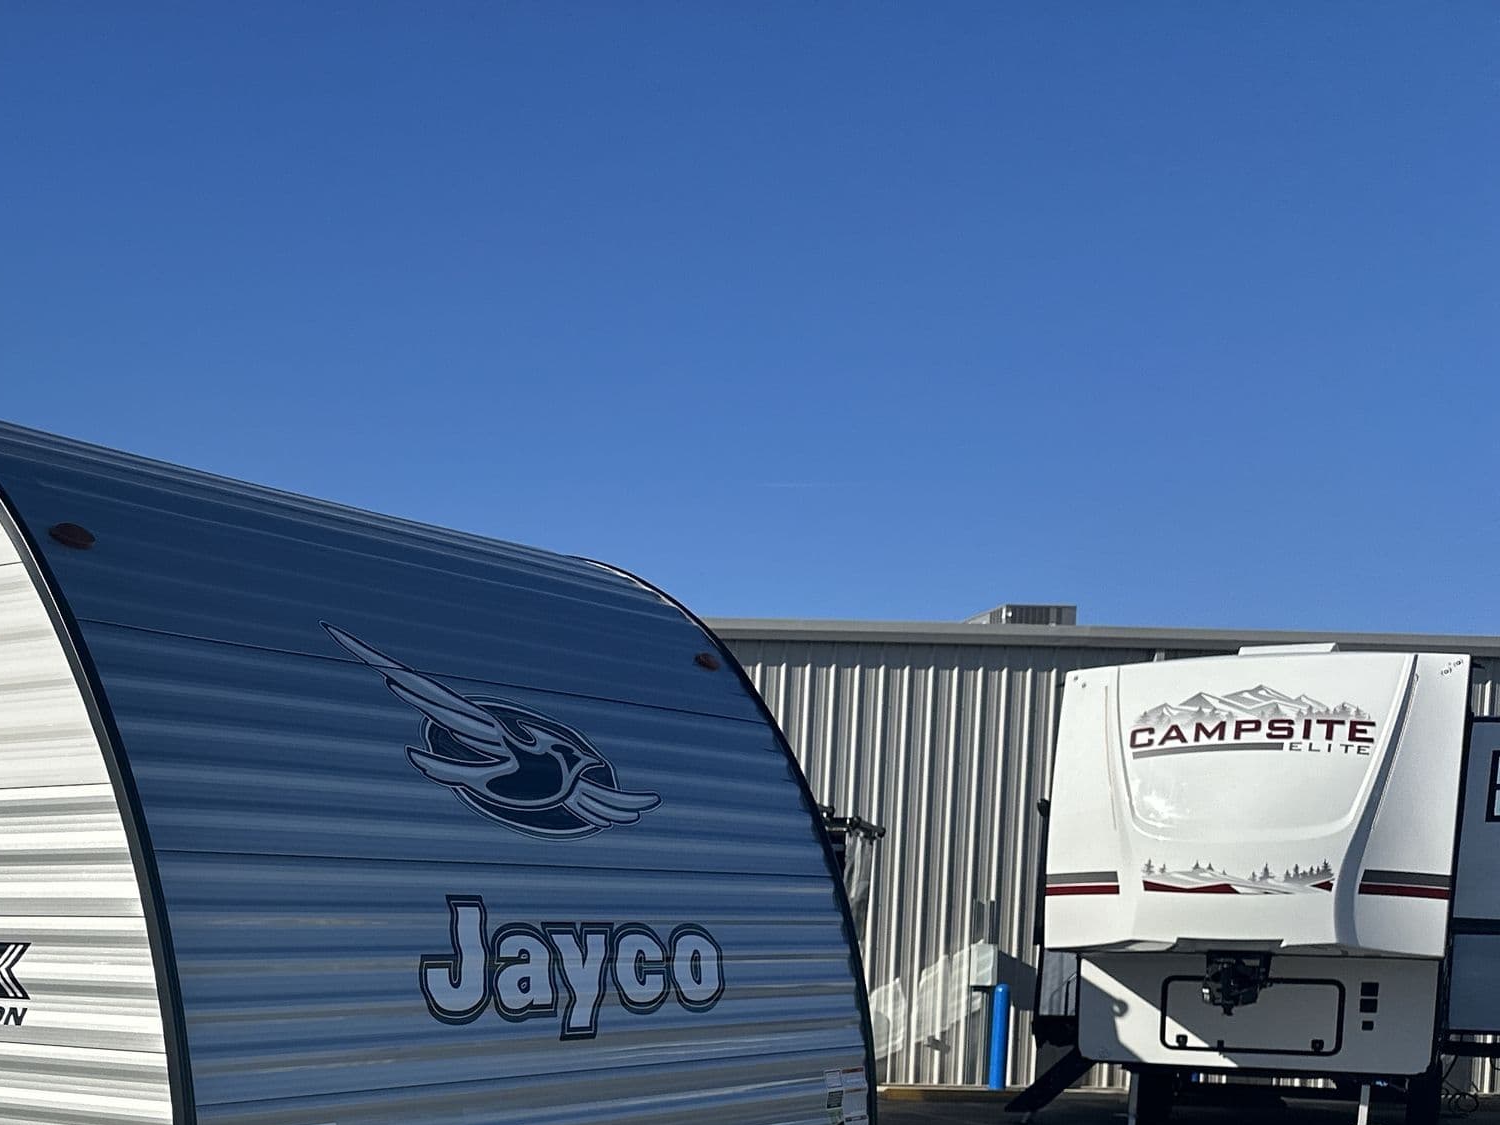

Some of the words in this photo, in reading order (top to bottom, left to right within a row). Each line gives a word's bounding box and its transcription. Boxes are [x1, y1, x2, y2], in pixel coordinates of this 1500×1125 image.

[1129, 718, 1377, 749] CAMPSITE
[1289, 741, 1371, 756] ELITE
[419, 894, 726, 1041] Jayco
